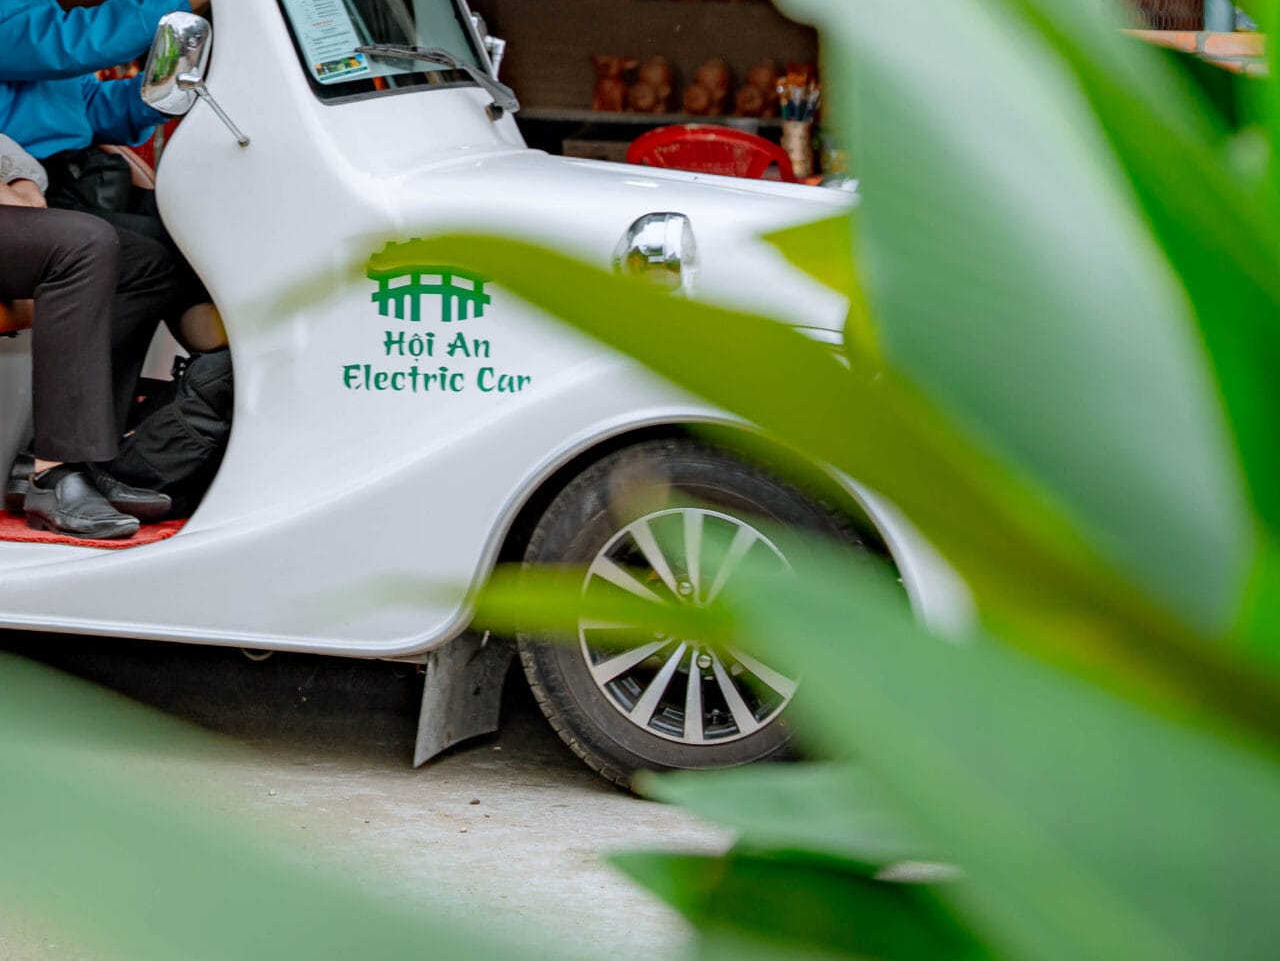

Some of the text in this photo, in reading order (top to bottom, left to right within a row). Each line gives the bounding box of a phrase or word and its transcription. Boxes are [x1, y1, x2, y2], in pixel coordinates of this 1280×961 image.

[383, 330, 491, 363] Hội An
[342, 364, 532, 394] Electric Car
